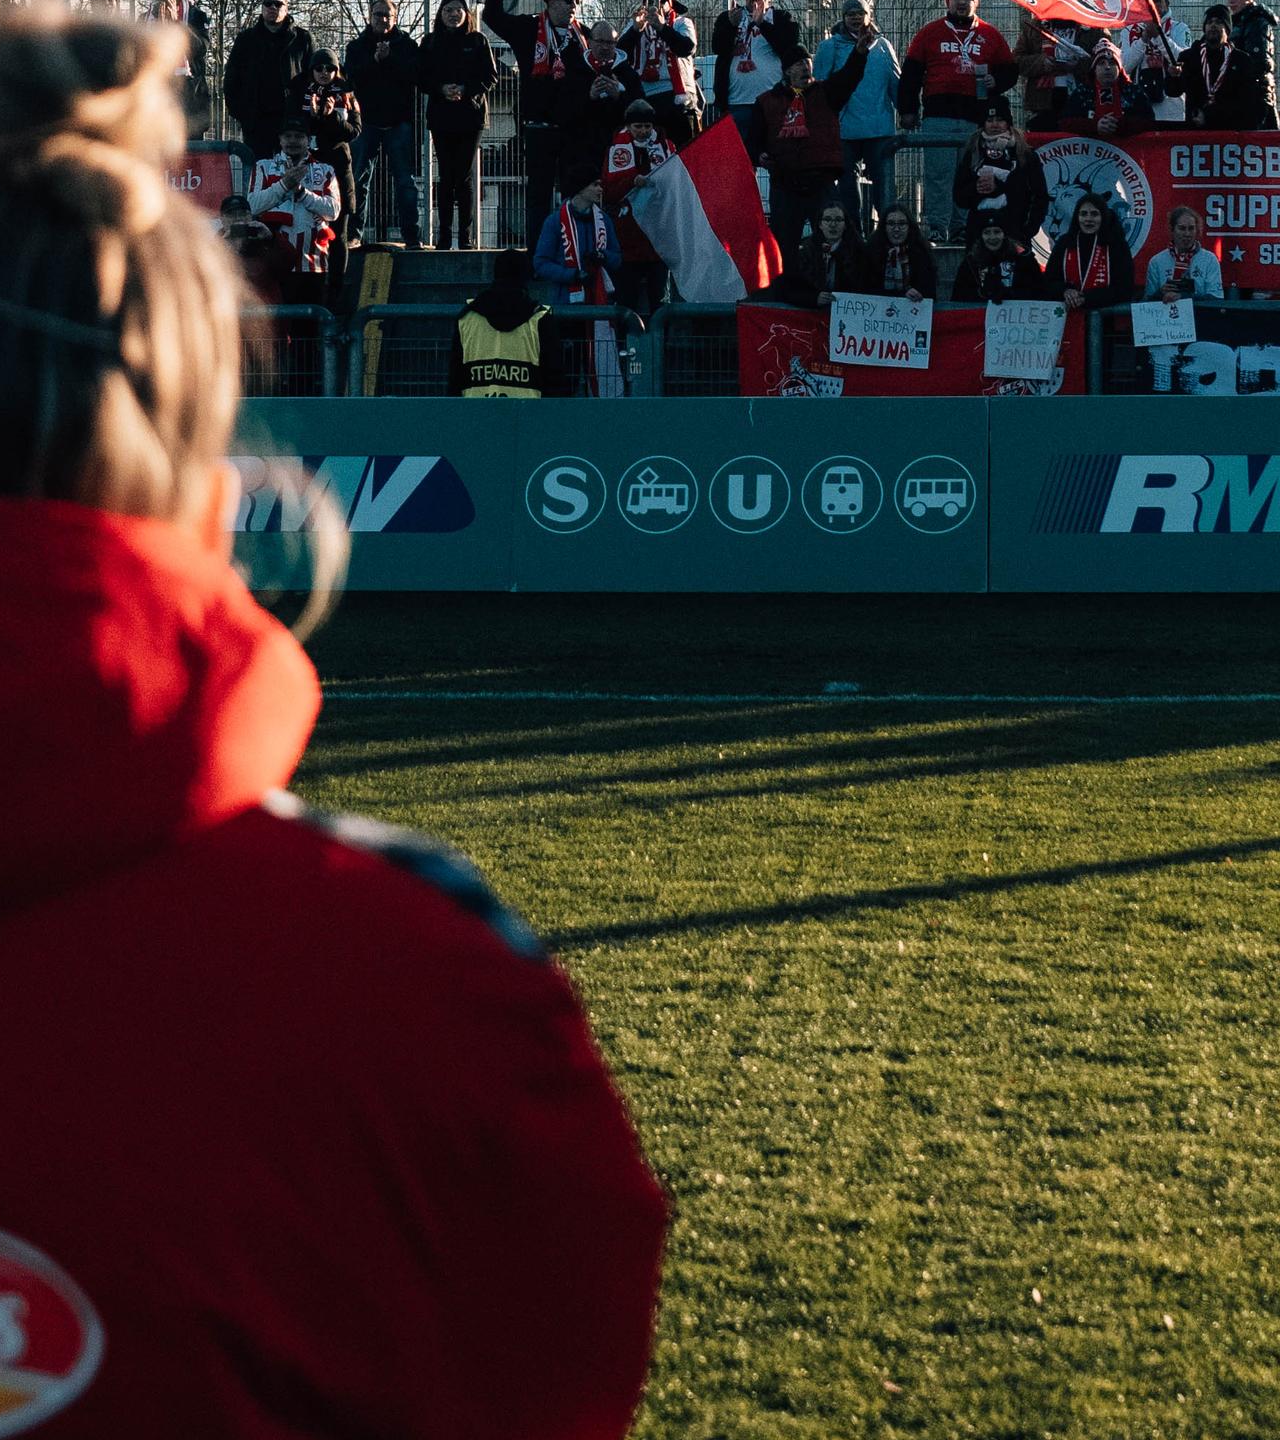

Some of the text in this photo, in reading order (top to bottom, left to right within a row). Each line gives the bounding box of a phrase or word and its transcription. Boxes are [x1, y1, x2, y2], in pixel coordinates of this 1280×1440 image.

[1094, 146, 1147, 217] SUPPORTERS
[835, 300, 878, 317] HAPPY
[996, 307, 1050, 325] ALLES
[863, 318, 917, 334] BIRTHDAY
[835, 335, 909, 361] JANINA
